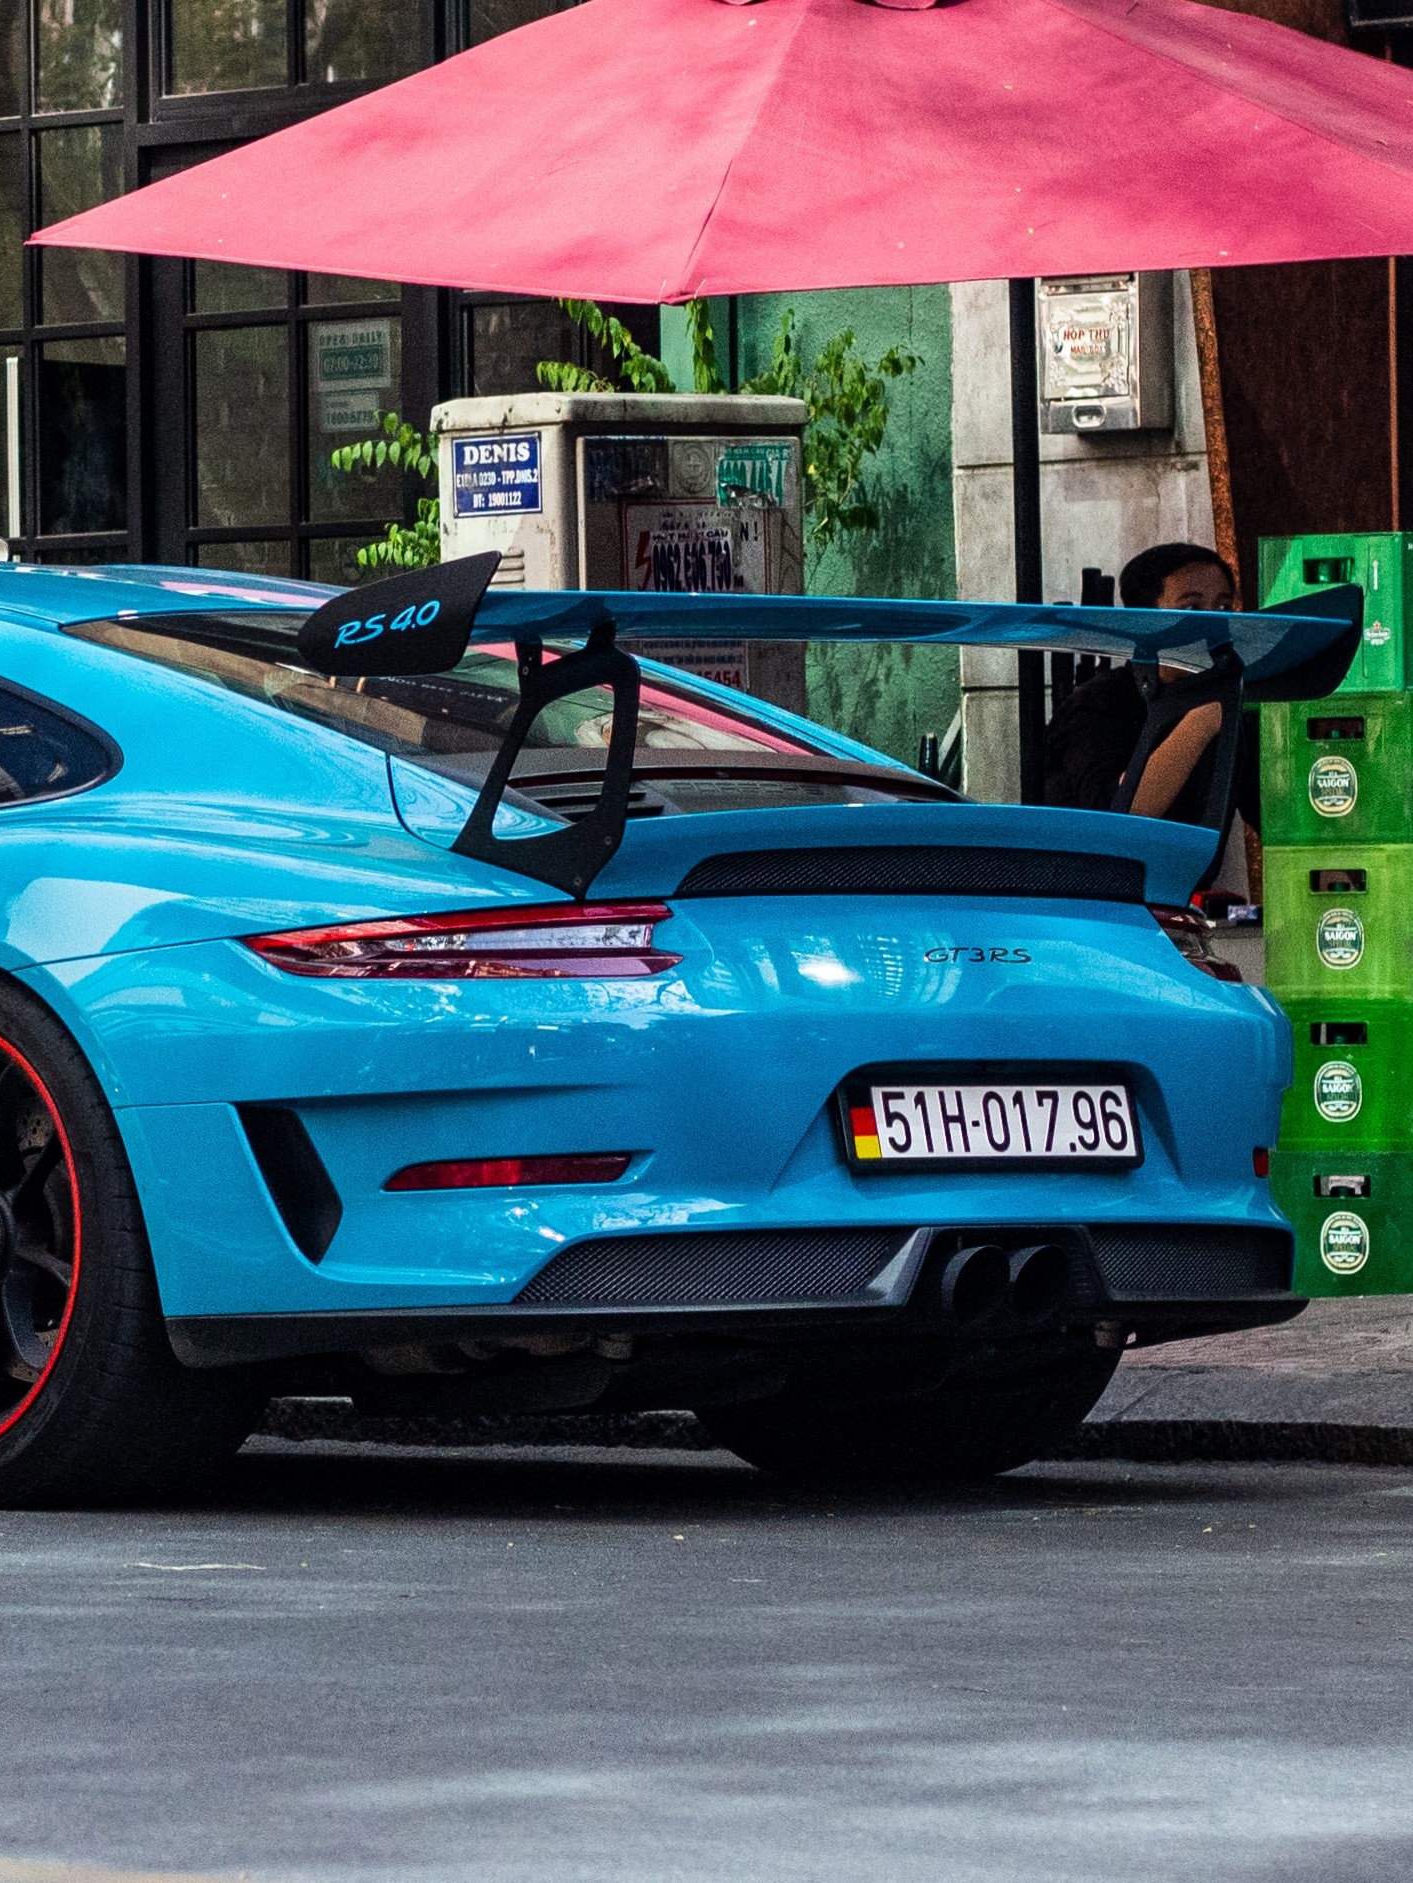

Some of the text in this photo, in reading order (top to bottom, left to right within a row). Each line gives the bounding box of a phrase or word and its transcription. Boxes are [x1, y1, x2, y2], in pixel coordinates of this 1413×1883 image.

[463, 442, 531, 465] DENIS
[488, 491, 522, 507] 19001122
[334, 600, 440, 649] RS 4.0
[1317, 778, 1351, 788] SAIGON
[1324, 930, 1358, 941] SAIGON
[881, 1090, 1128, 1152] 51H-017.96
